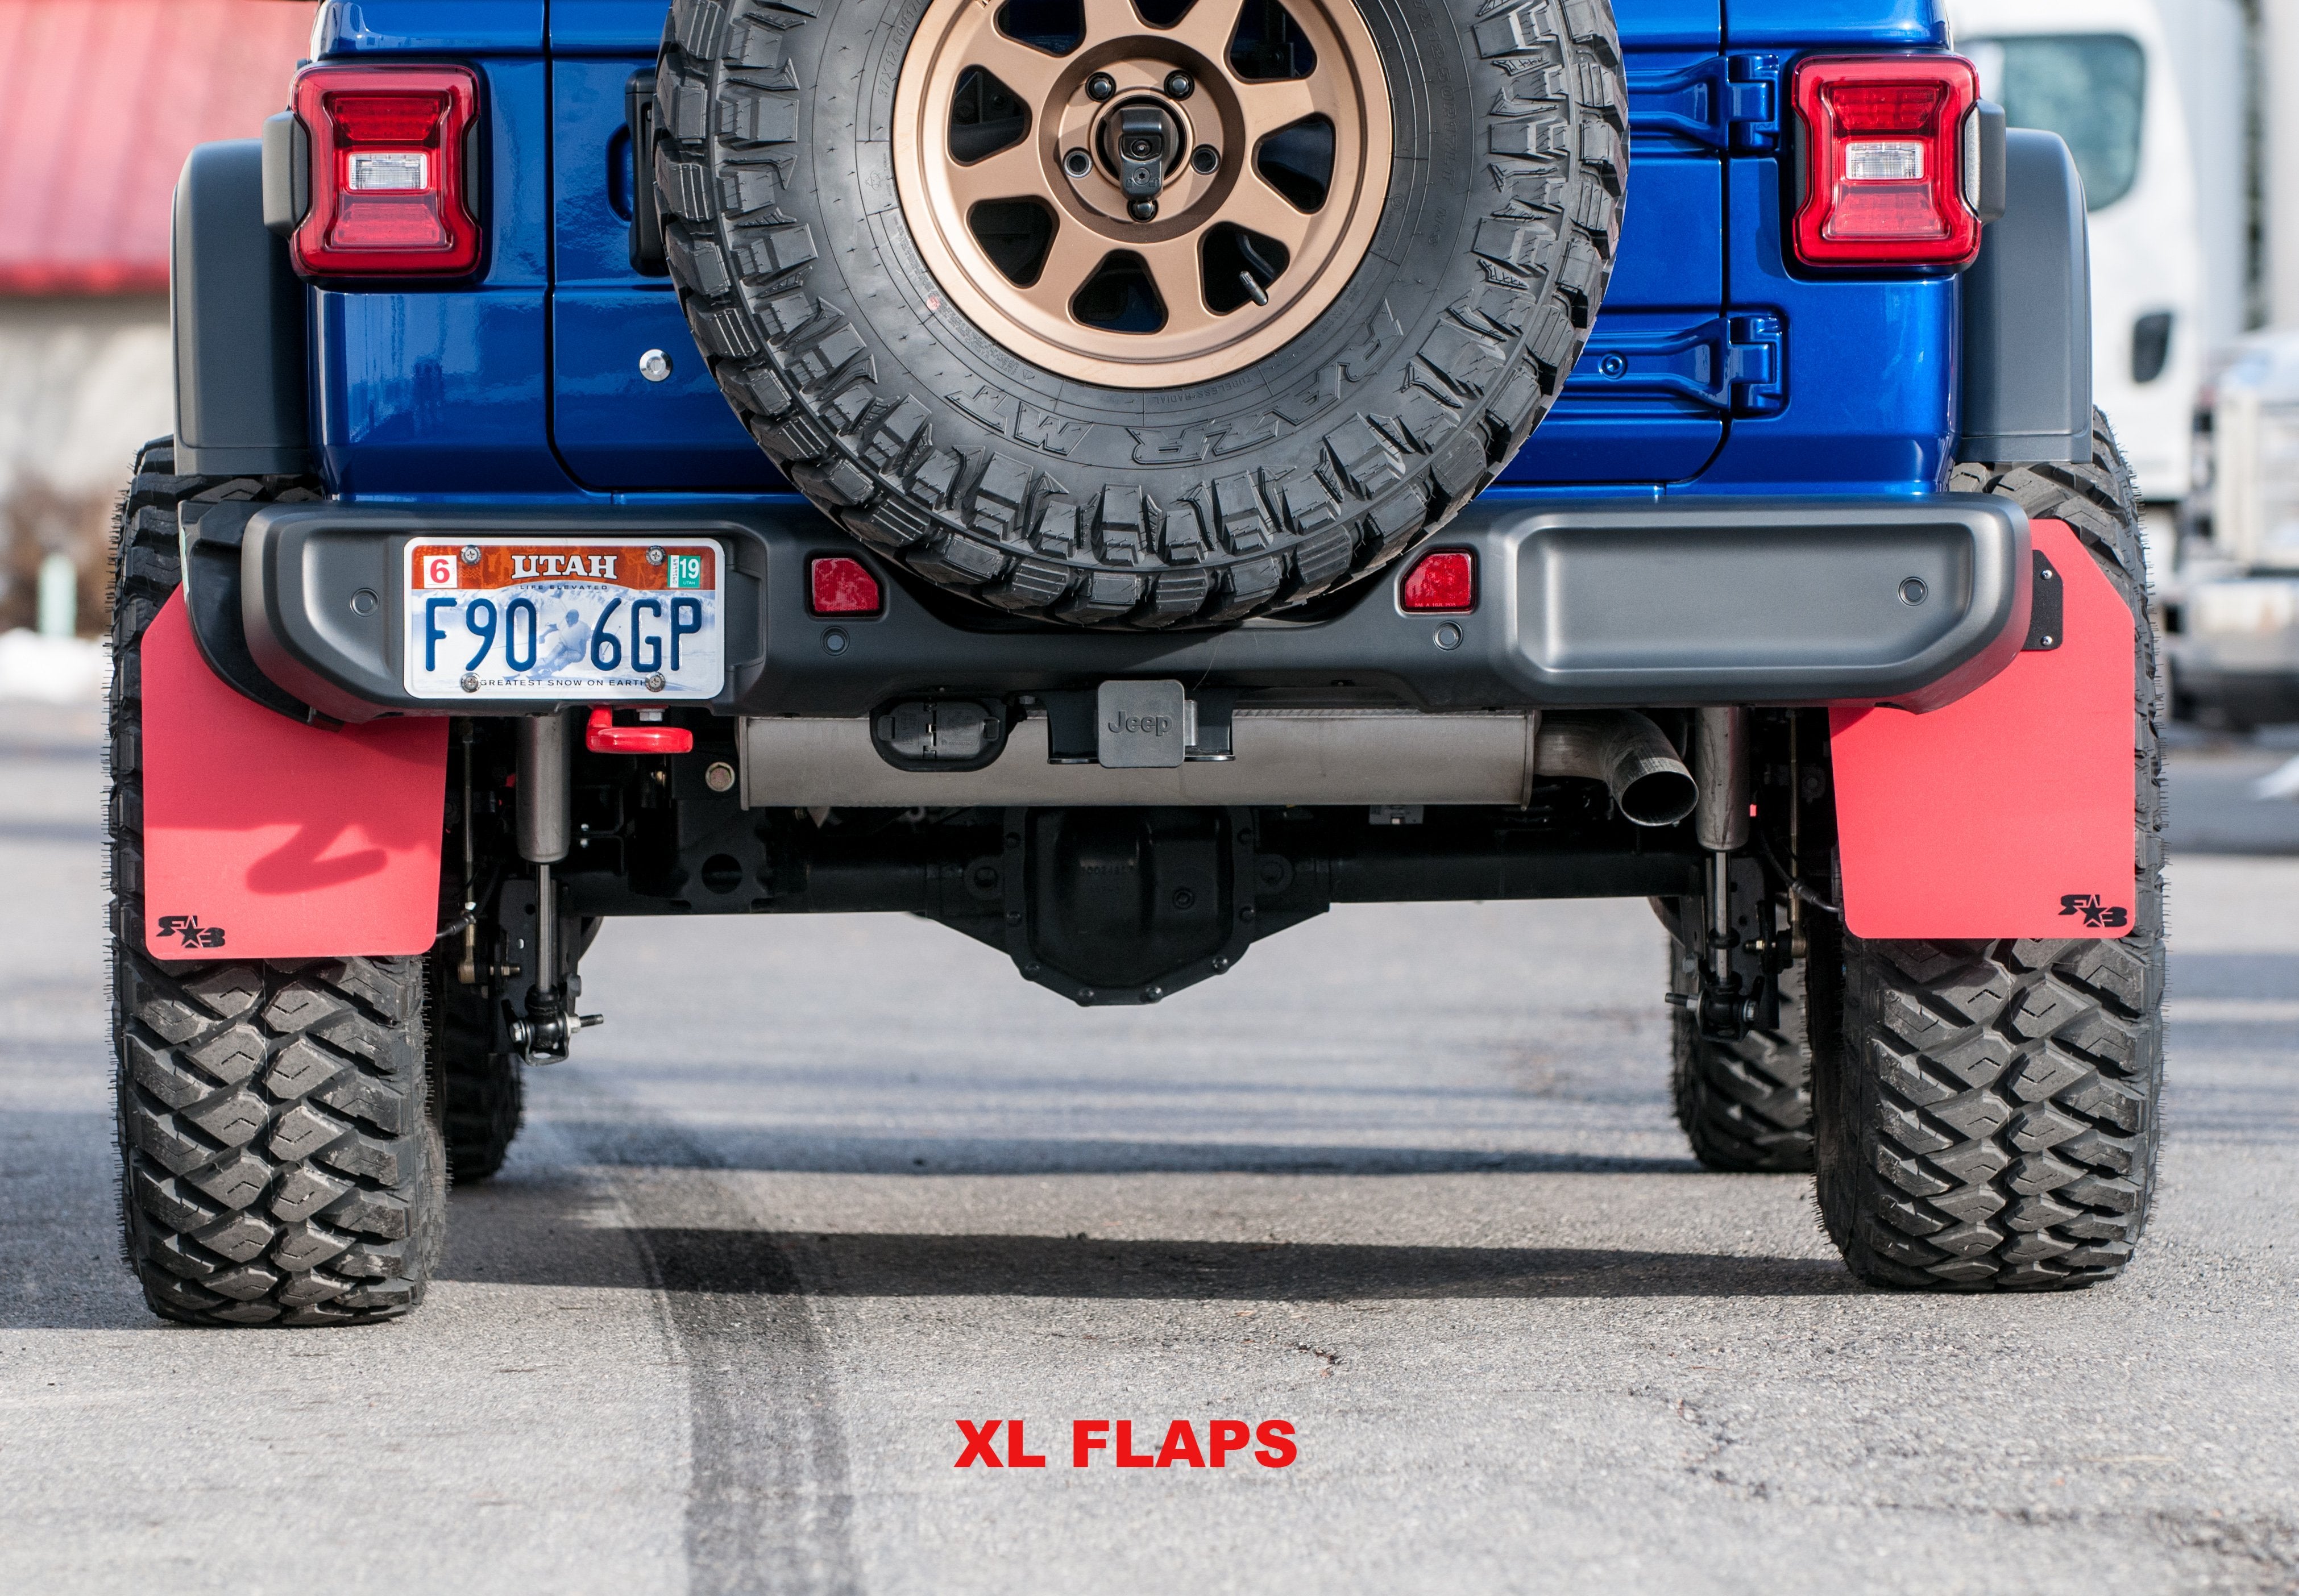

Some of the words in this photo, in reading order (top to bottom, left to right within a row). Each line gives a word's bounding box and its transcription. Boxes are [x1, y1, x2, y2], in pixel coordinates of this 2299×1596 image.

[1152, 392, 1192, 405] RADIAL
[1195, 375, 1252, 399] TUBELESS
[430, 559, 450, 583] 6
[511, 555, 617, 580] UTAH
[679, 558, 699, 579] 19
[425, 597, 537, 672] F90
[590, 597, 703, 672] 6GP
[1108, 711, 1173, 737] Jeep
